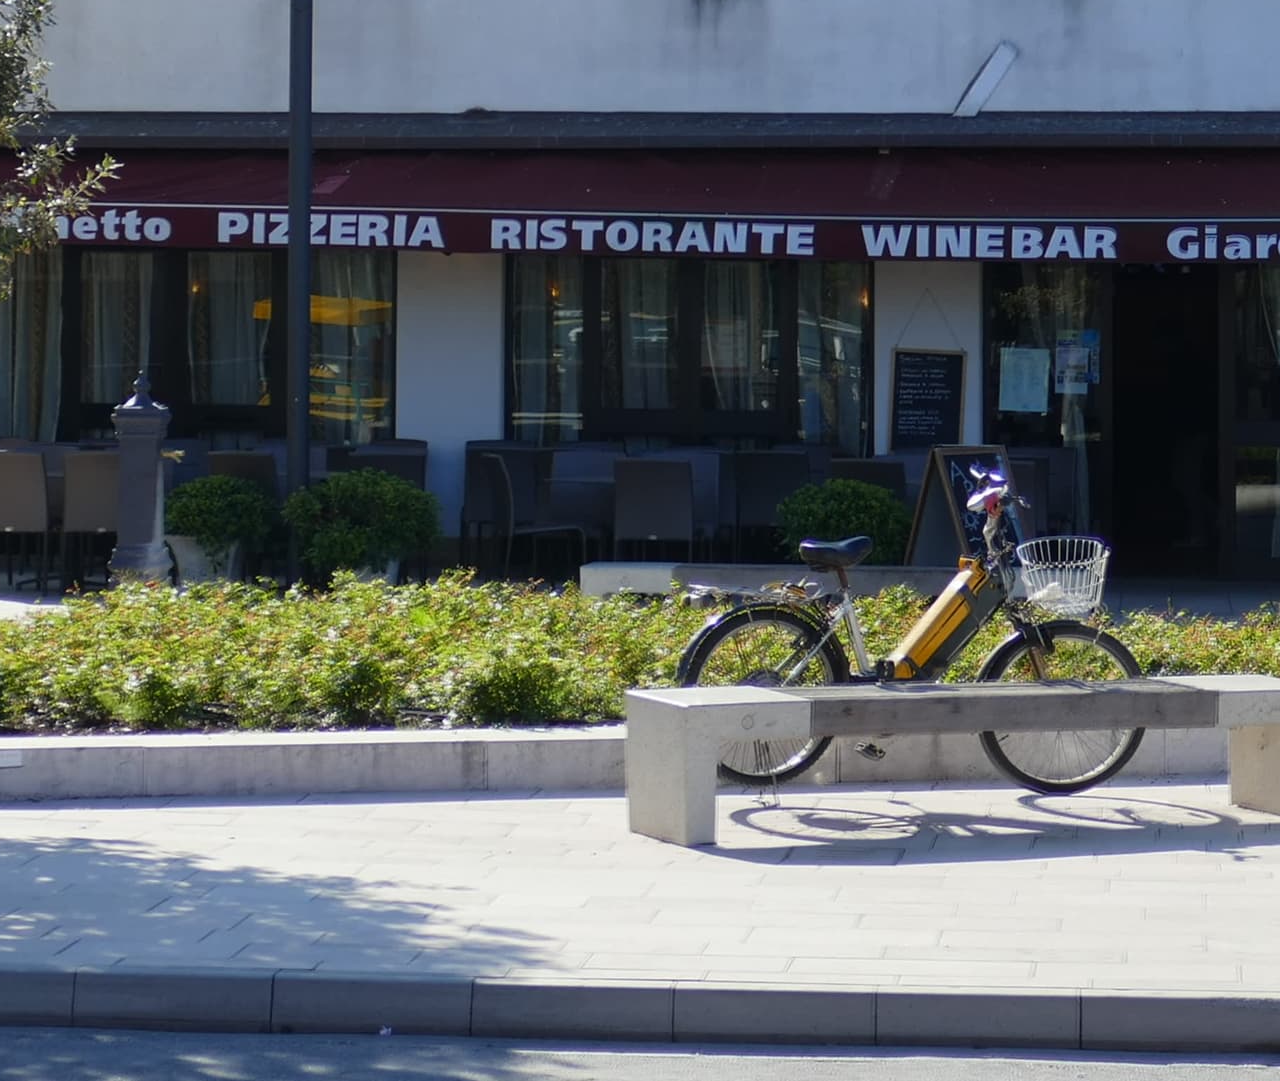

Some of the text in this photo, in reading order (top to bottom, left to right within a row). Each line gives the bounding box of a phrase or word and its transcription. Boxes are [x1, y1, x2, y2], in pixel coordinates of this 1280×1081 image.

[218, 212, 445, 248] PIZZERIA
[490, 219, 815, 256] RISTORANTE
[862, 224, 1118, 259] WINEBAR
